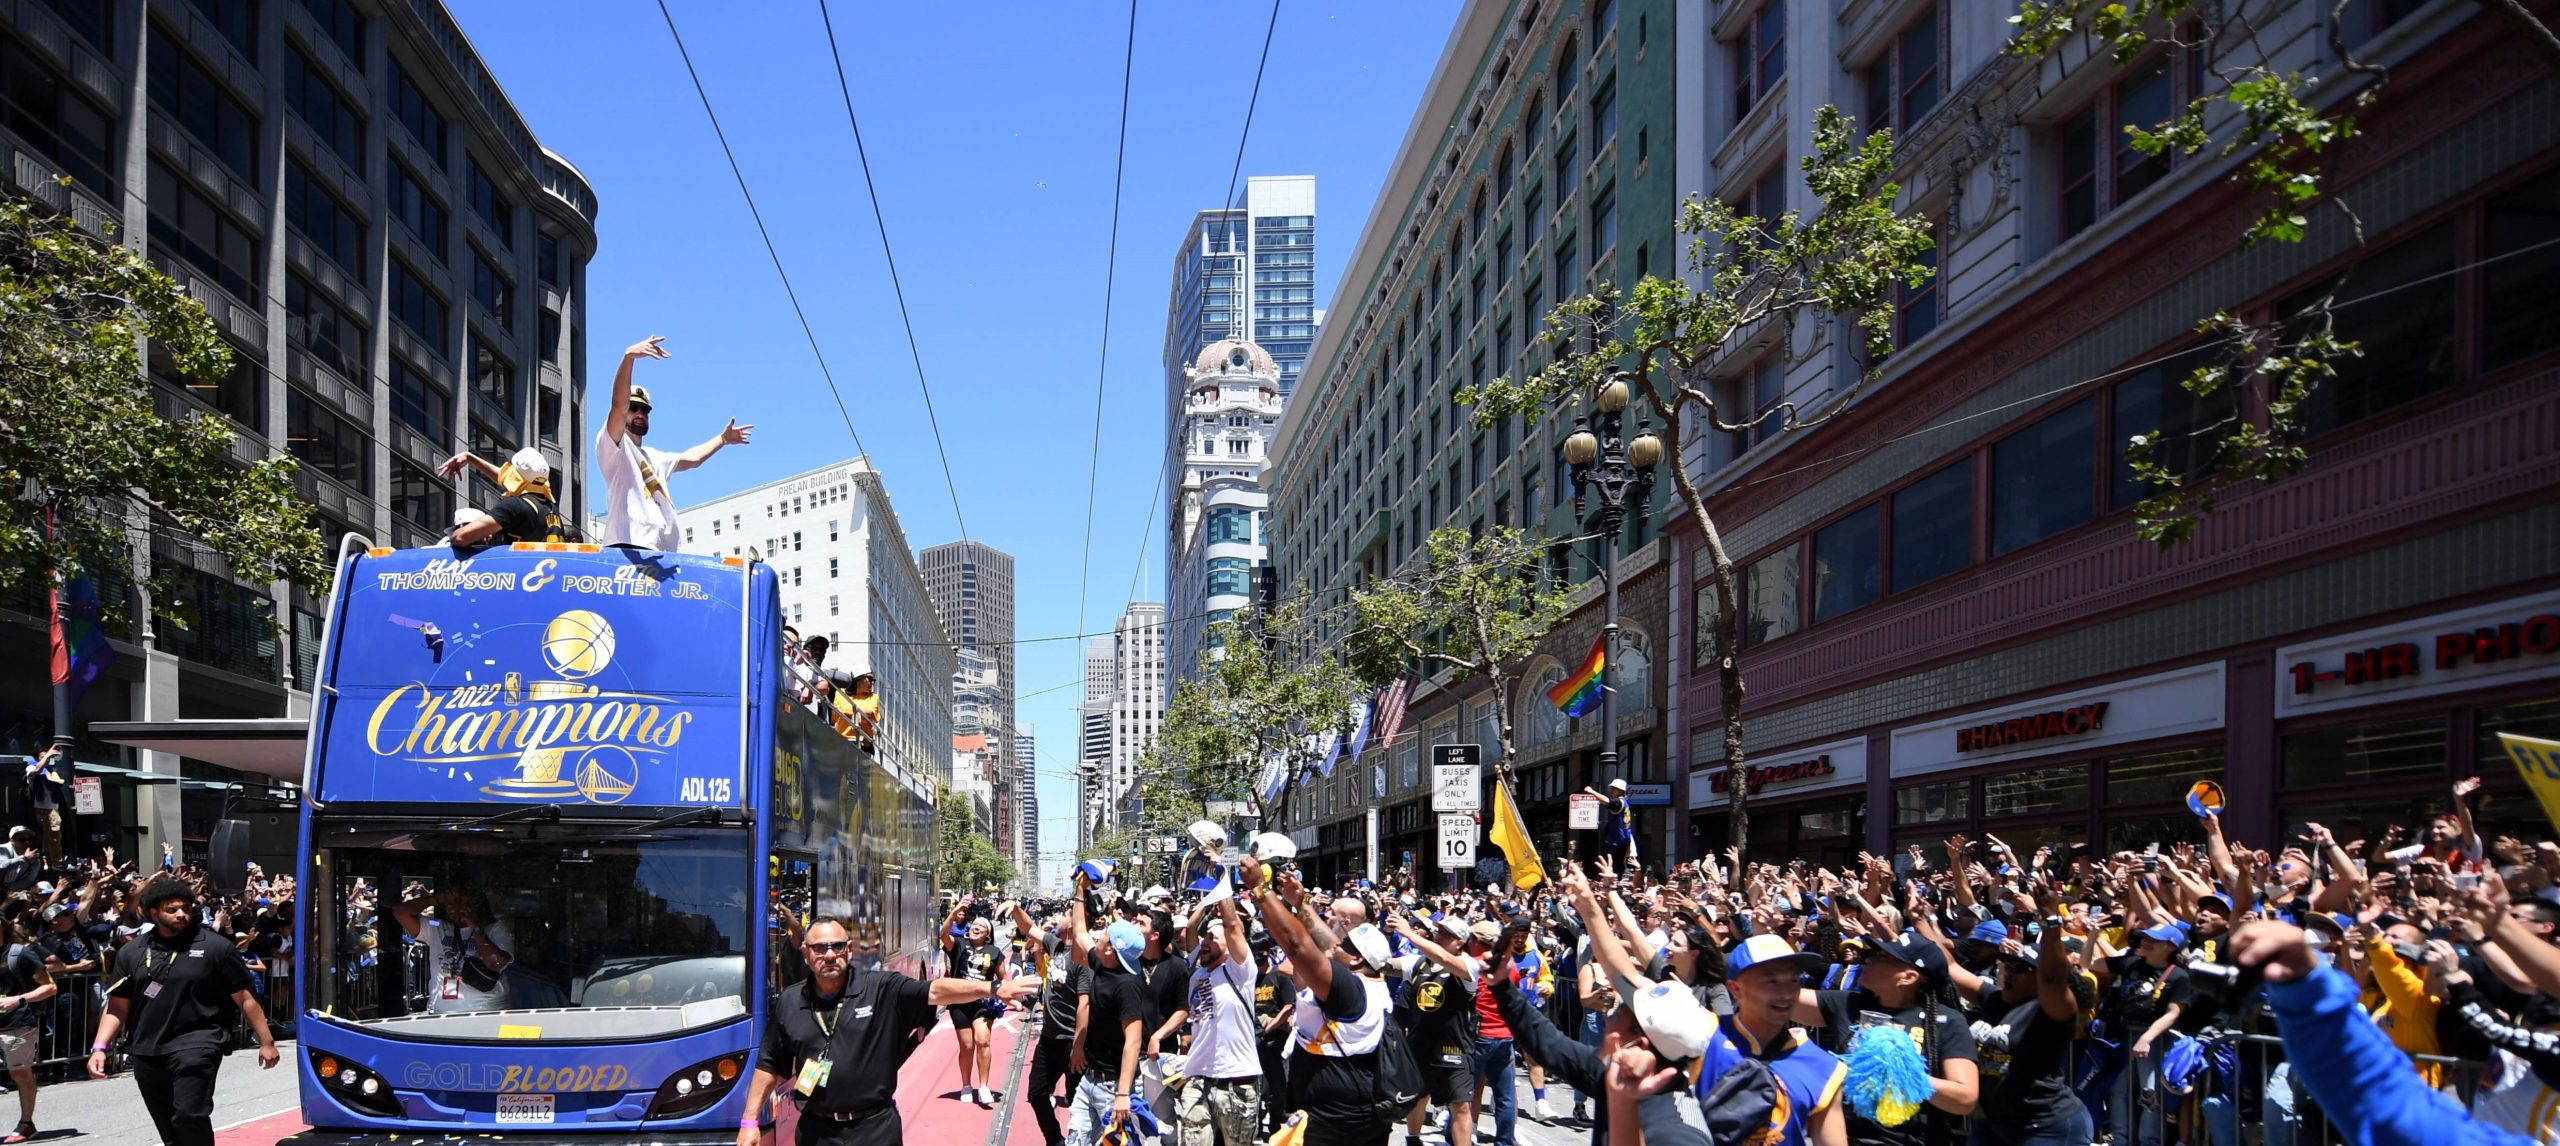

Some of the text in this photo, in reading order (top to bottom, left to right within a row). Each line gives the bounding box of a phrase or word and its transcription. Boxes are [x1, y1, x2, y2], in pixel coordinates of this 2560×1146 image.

[779, 468, 847, 497] PHELAN BUILDING
[378, 559, 709, 600] THOMPSON & PORTER JR.
[422, 558, 475, 576] KLAY
[2290, 613, 2560, 695] 1-HR PHO
[444, 683, 502, 709] 2022
[366, 681, 692, 771] Champions
[1957, 702, 2109, 753] PHARMACY
[774, 747, 792, 785] BIG
[1442, 768, 1470, 776] BUSES
[1708, 755, 1835, 795] Wgreens
[1445, 779, 1468, 787] TAXIS
[1445, 790, 1467, 798] ONLY
[1442, 819, 1472, 827] SPEED
[1444, 829, 1469, 837] LIMIT
[1446, 839, 1467, 857] 10
[1199, 977, 1215, 1021] CHAMPS
[1428, 986, 1442, 996] 30
[404, 1061, 508, 1091] GOLD
[497, 1064, 628, 1093] BLOODED
[500, 1105, 551, 1119] 86281L2
